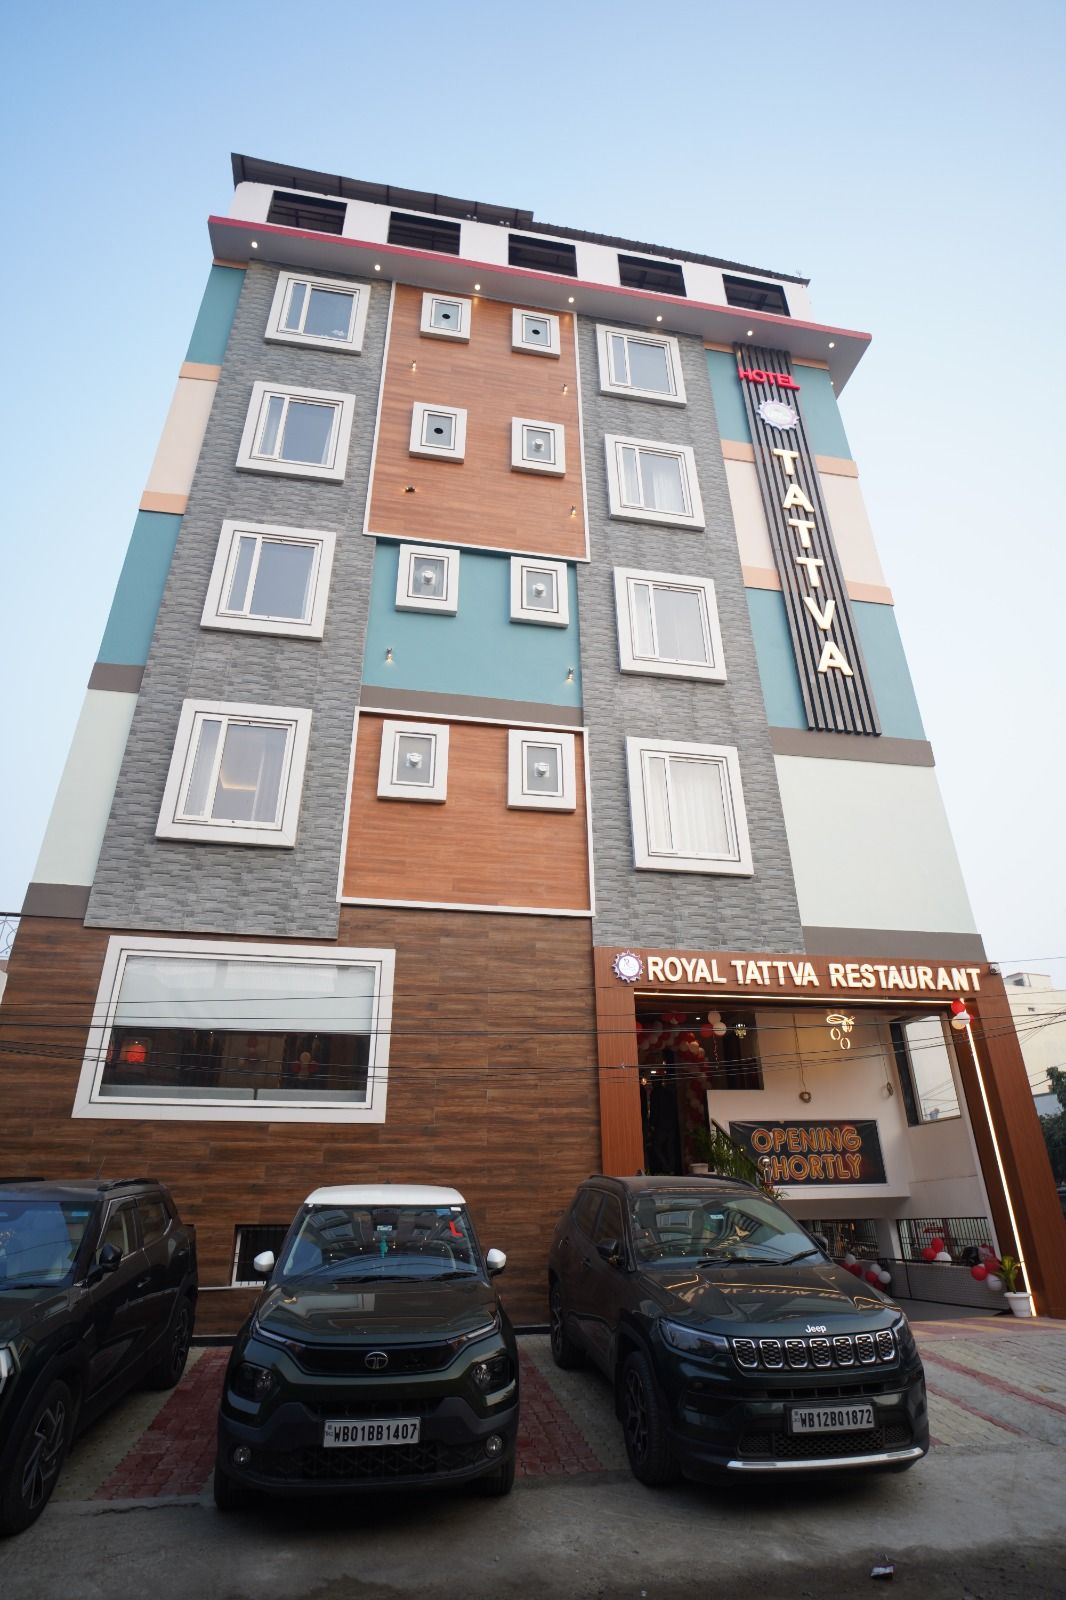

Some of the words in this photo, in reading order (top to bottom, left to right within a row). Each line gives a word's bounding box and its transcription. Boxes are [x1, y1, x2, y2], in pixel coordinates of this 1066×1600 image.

[738, 368, 800, 390] HOTEL
[772, 448, 854, 677] TATTVA
[647, 956, 727, 984] ROYAL
[731, 960, 819, 988] TATTVA
[829, 963, 981, 991] RESTAURANT
[751, 1127, 862, 1153] OPENING
[805, 1324, 827, 1333] Jeep
[799, 1409, 873, 1428] WB12BQ1872
[334, 1423, 417, 1442] WB01BB1407
